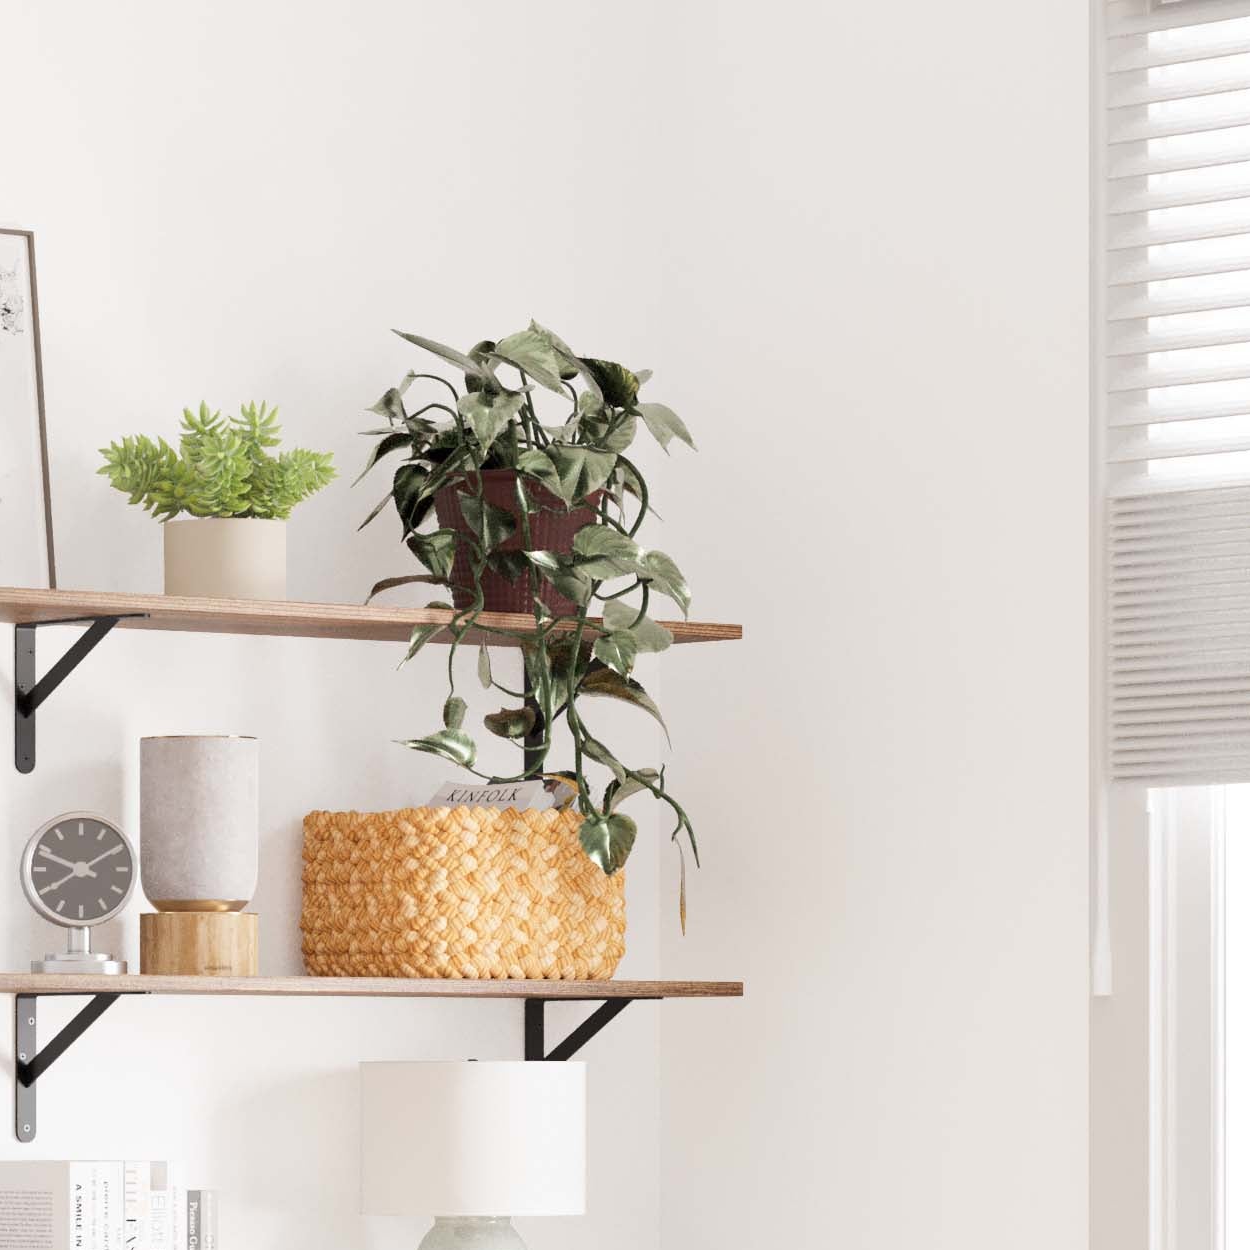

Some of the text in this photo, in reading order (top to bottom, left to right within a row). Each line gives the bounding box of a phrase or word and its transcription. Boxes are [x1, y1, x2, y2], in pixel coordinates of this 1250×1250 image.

[446, 787, 524, 803] KINFOLK
[75, 1183, 83, 1191] A
[75, 1195, 83, 1230] SMILE
[150, 1195, 167, 1241] Elliott
[188, 1202, 198, 1234] Picasso
[75, 1235, 83, 1247] IN
